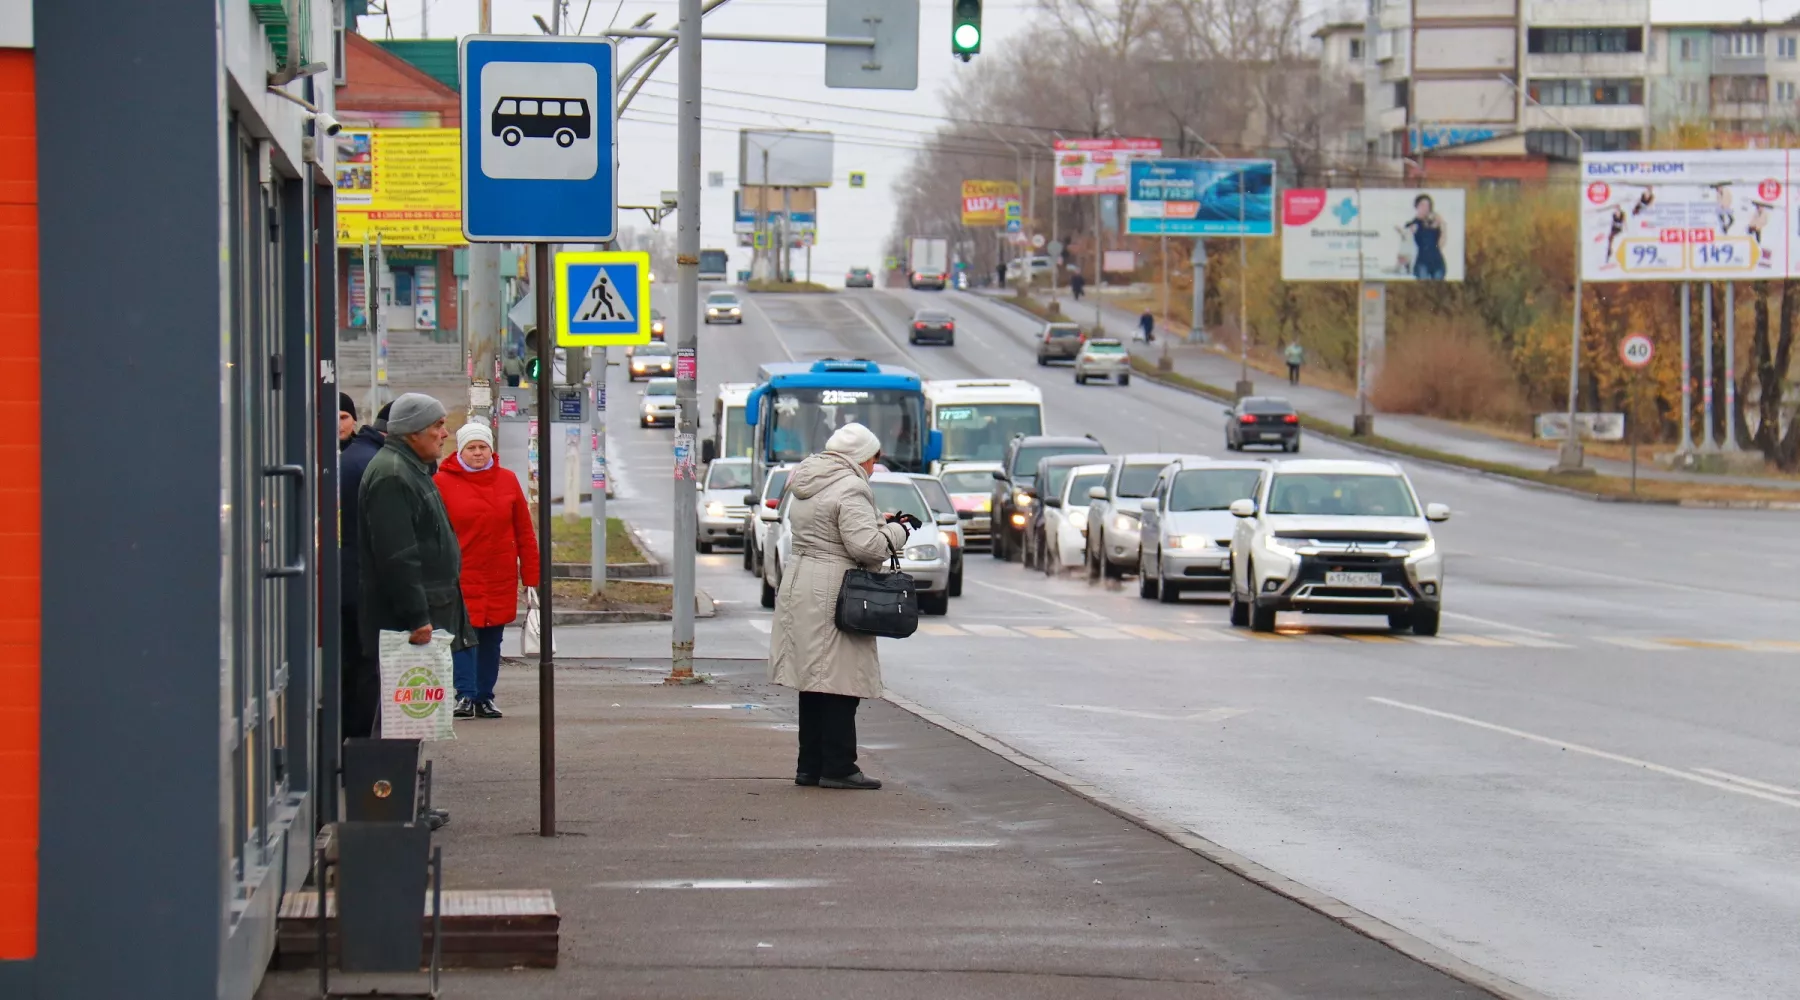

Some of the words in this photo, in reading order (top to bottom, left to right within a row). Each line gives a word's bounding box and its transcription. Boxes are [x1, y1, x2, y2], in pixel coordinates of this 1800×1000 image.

[1632, 245, 1658, 264] 99
[1699, 244, 1734, 264] 149
[1627, 343, 1648, 357] 40
[822, 389, 838, 404] 23
